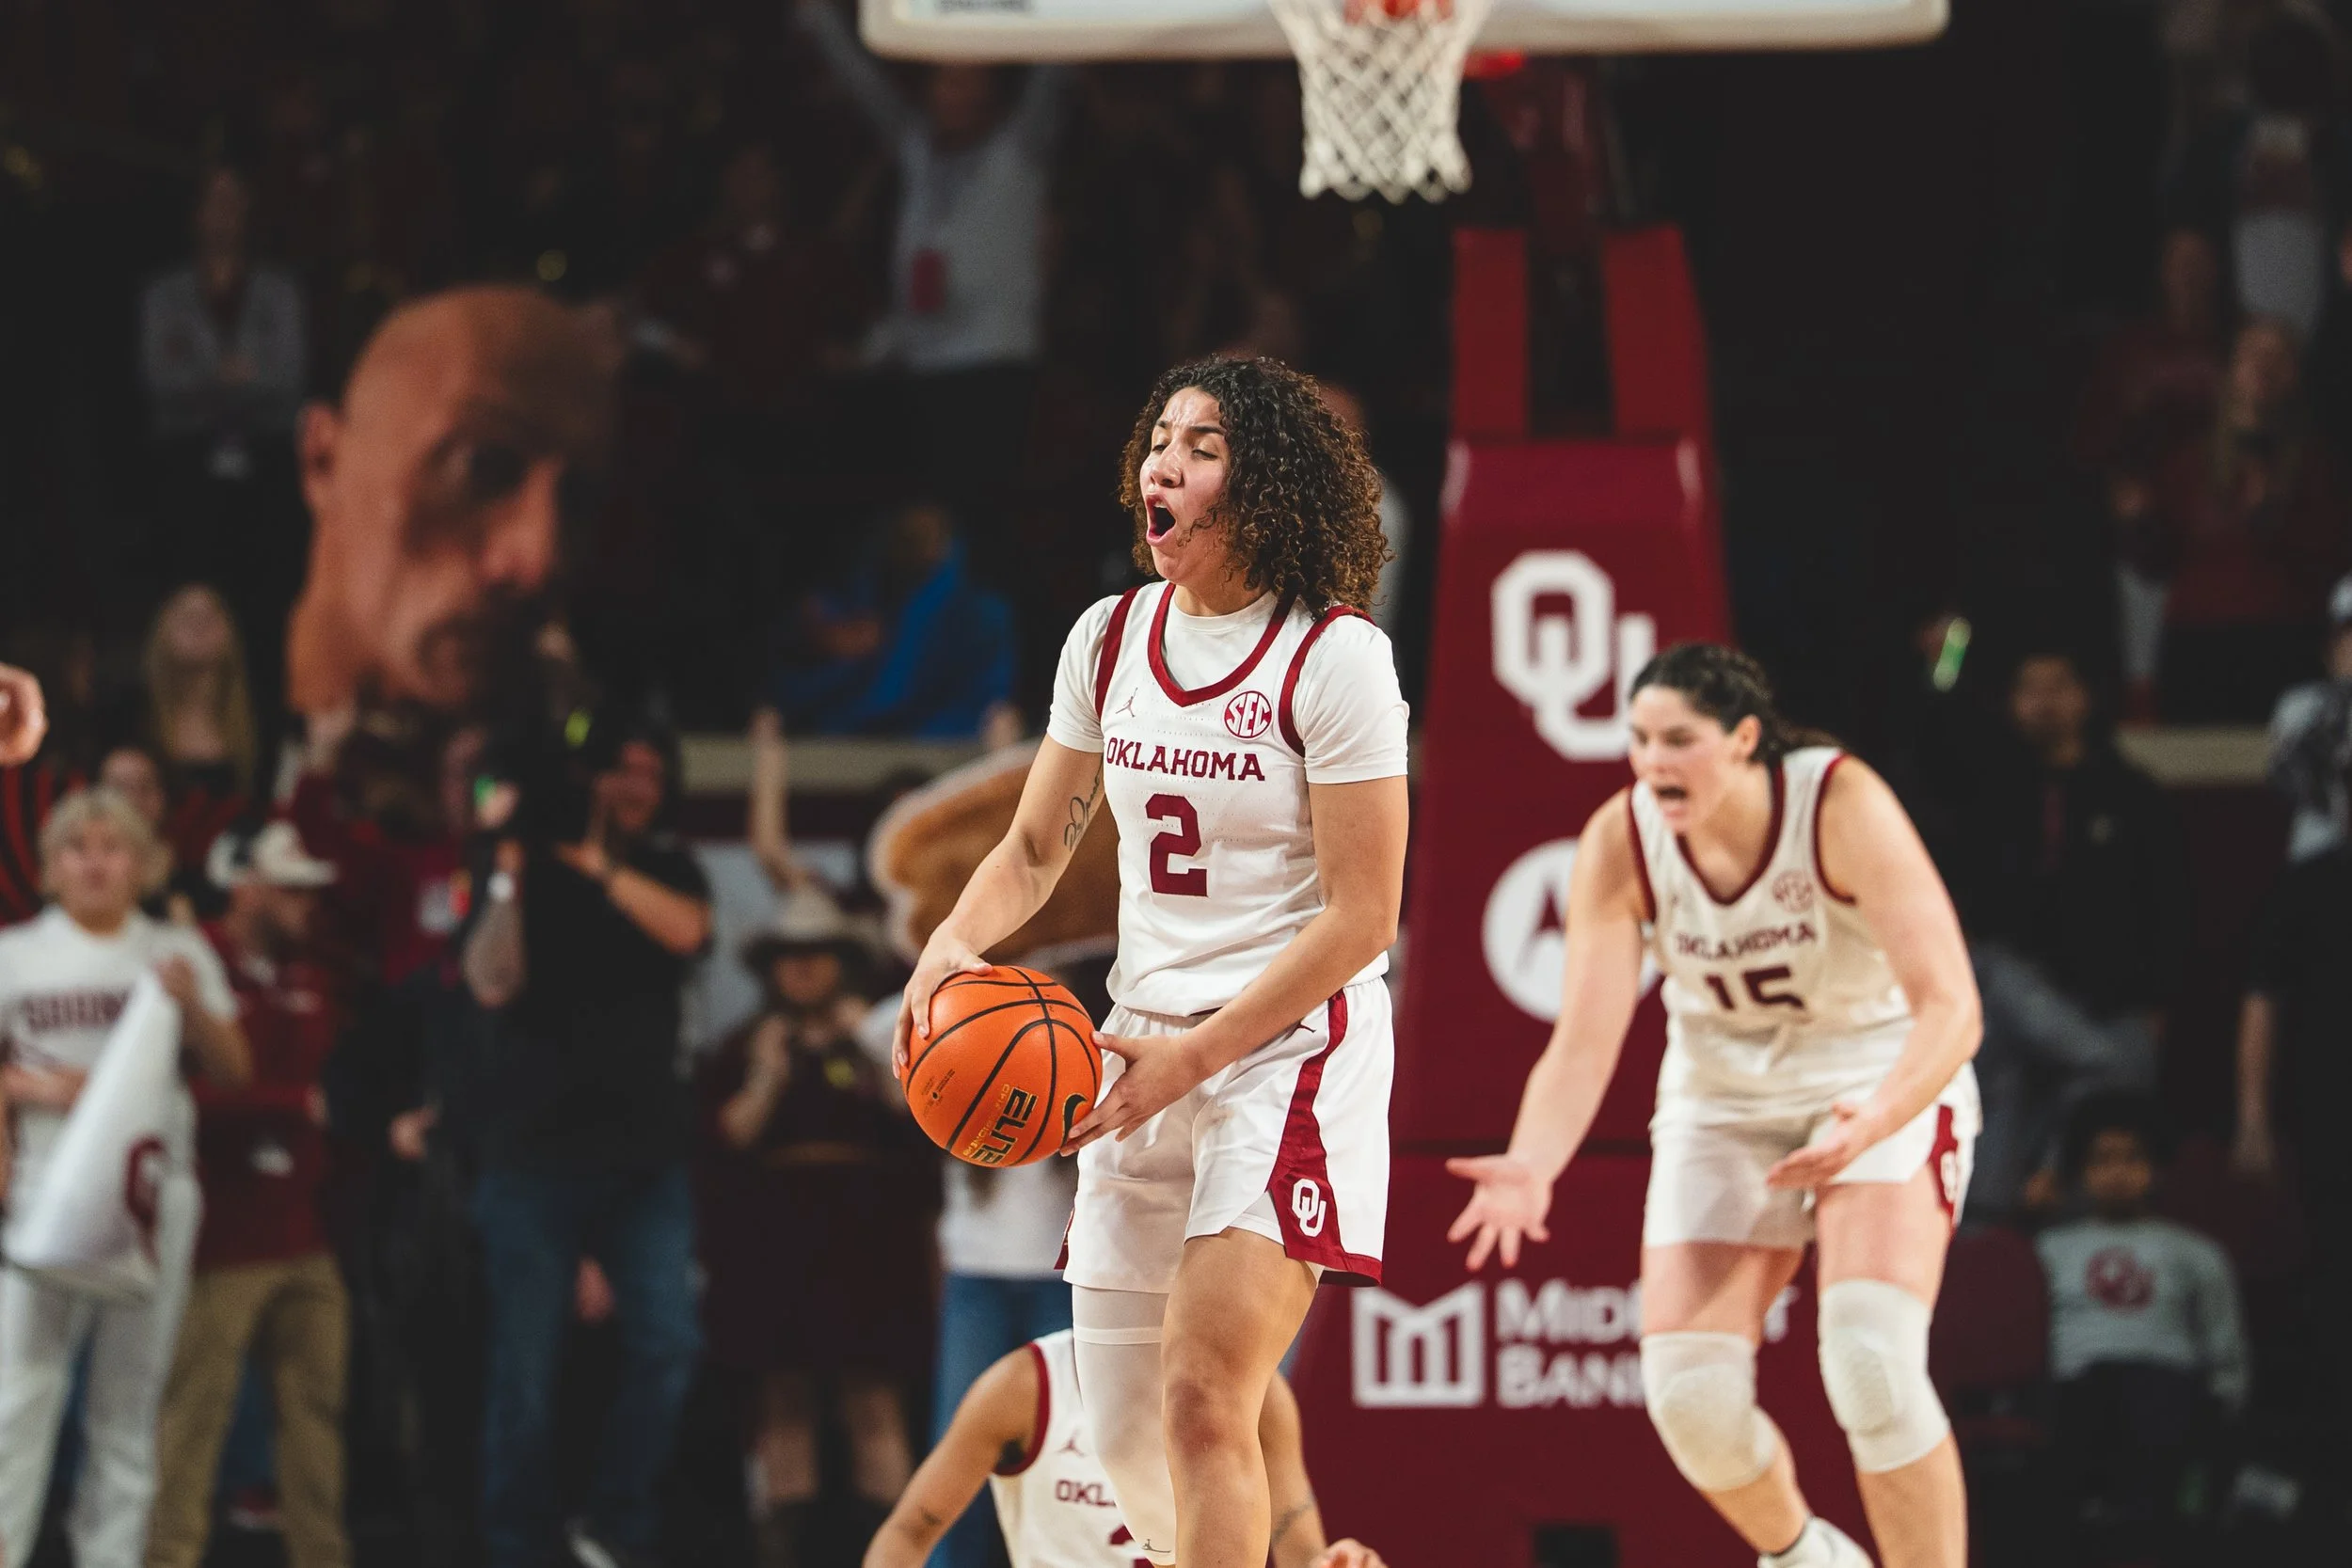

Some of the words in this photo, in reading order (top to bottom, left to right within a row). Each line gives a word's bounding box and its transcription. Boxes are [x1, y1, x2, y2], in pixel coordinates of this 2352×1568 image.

[1491, 549, 1657, 761] OU
[1225, 691, 1271, 738] SEC
[1106, 736, 1265, 782] OKLAHOMA
[1145, 793, 1209, 897] 2
[1704, 963, 1805, 1011] 15
[970, 1086, 1039, 1165] ELITE
[1291, 1178, 1327, 1238] OU
[1495, 1343, 1645, 1409] BAN
[1055, 1479, 1117, 1508] OKL
